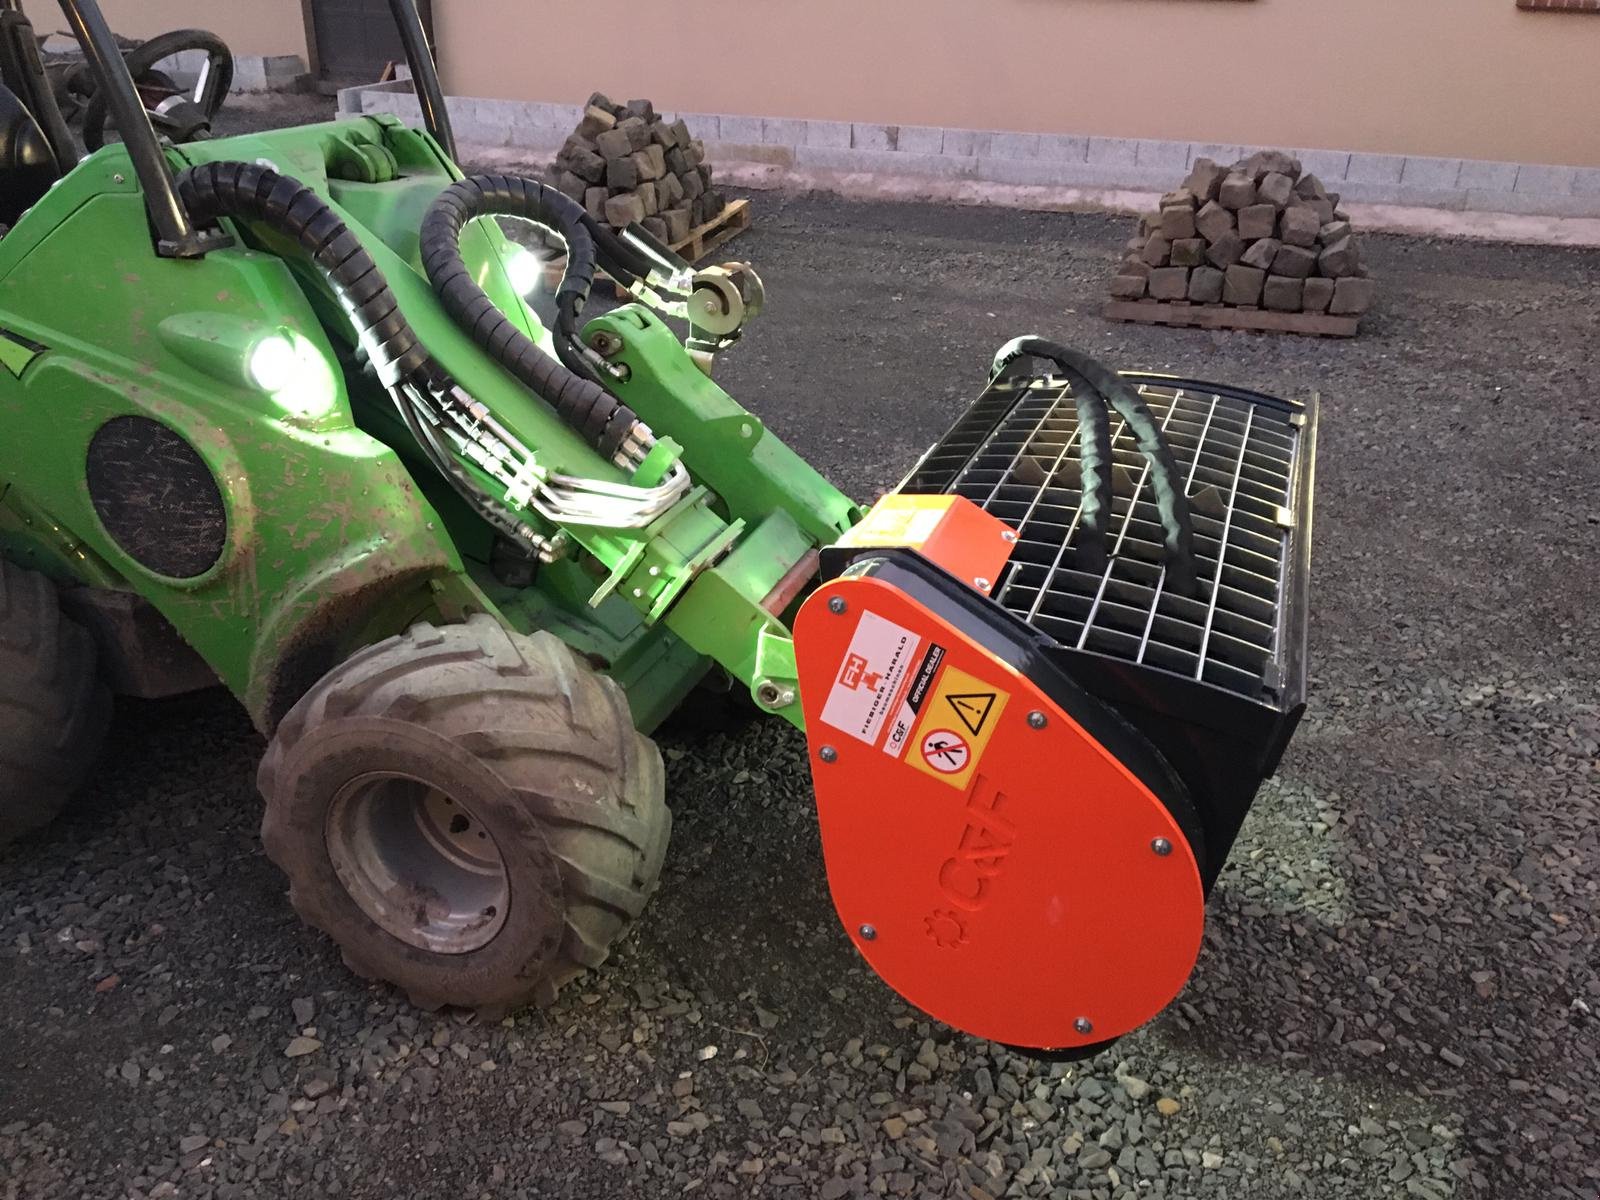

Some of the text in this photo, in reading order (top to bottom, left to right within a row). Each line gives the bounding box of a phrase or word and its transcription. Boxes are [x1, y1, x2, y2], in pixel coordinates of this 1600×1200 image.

[843, 657, 864, 687] FH
[861, 686, 886, 734] FIEBIGER
[885, 636, 907, 681] HARALD
[911, 672, 931, 703] OFFICIAL
[926, 646, 943, 674] DEALER
[892, 720, 907, 743] C&F
